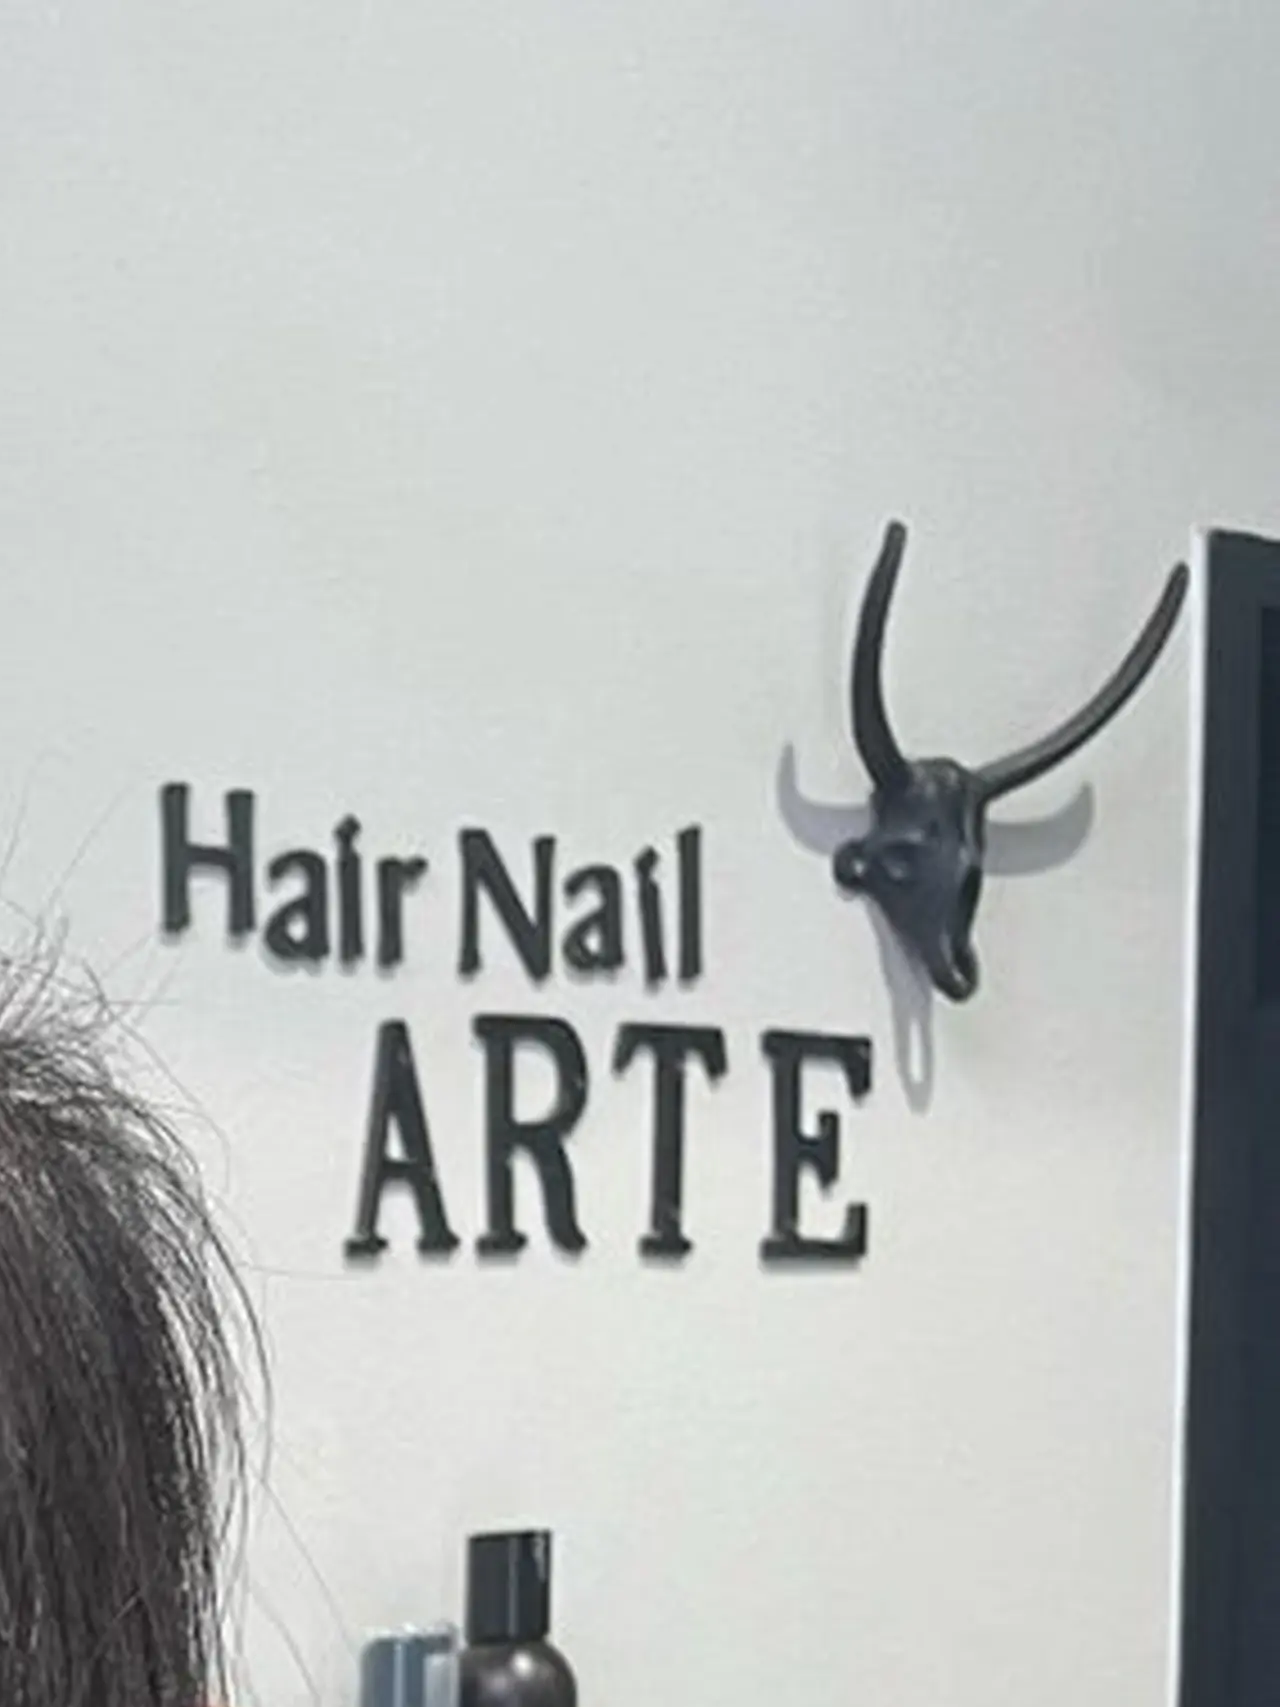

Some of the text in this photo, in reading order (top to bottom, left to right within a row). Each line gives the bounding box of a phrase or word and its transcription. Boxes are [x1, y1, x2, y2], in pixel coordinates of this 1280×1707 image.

[161, 782, 701, 985] Hair Nail
[345, 1014, 872, 1263] ARTE
